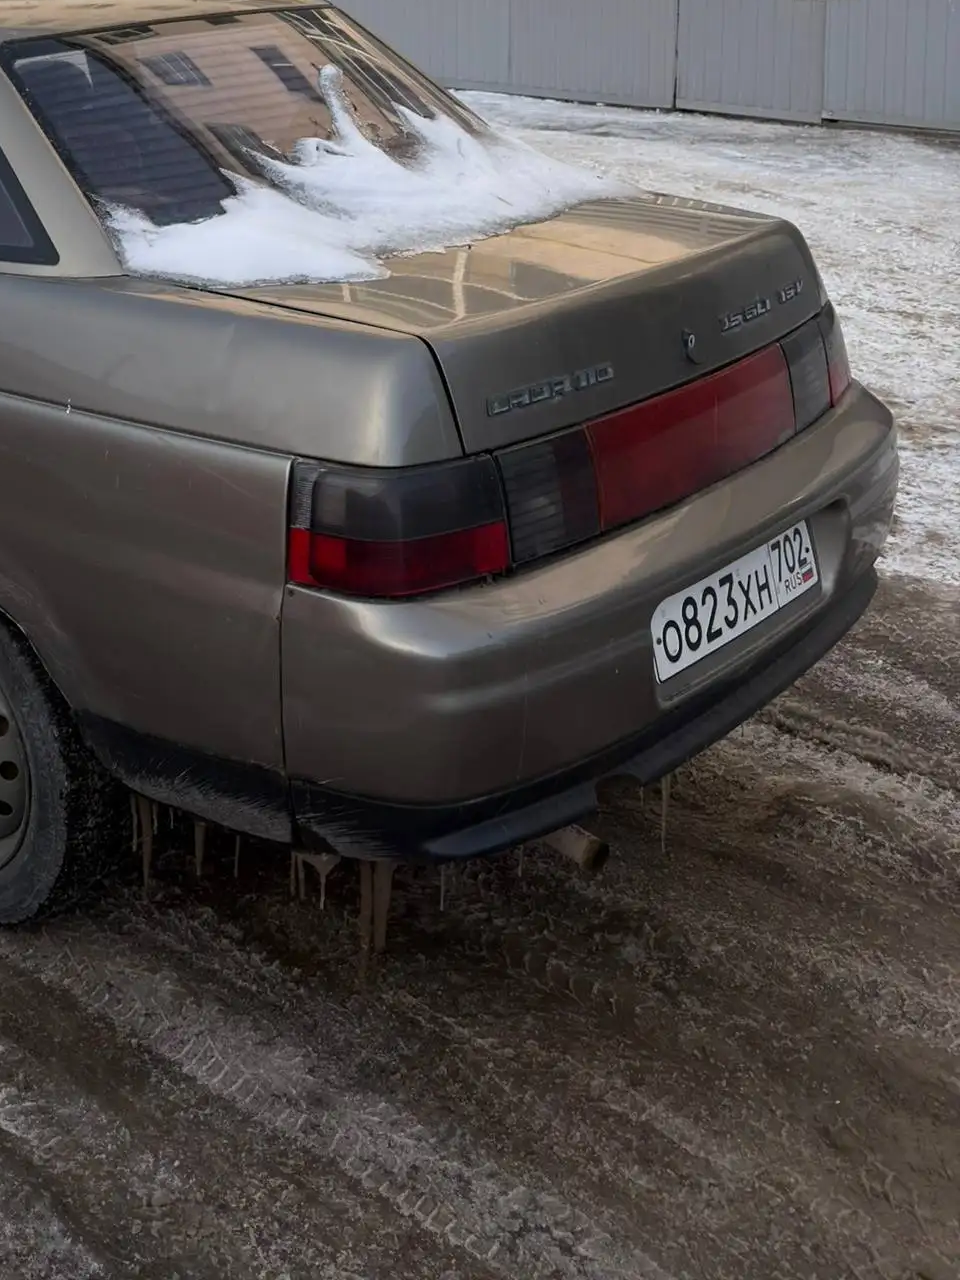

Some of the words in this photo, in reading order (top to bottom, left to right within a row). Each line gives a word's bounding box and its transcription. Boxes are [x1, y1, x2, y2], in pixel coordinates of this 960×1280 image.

[486, 374, 572, 417] LADA
[771, 527, 808, 583] 702
[784, 571, 803, 594] RUS
